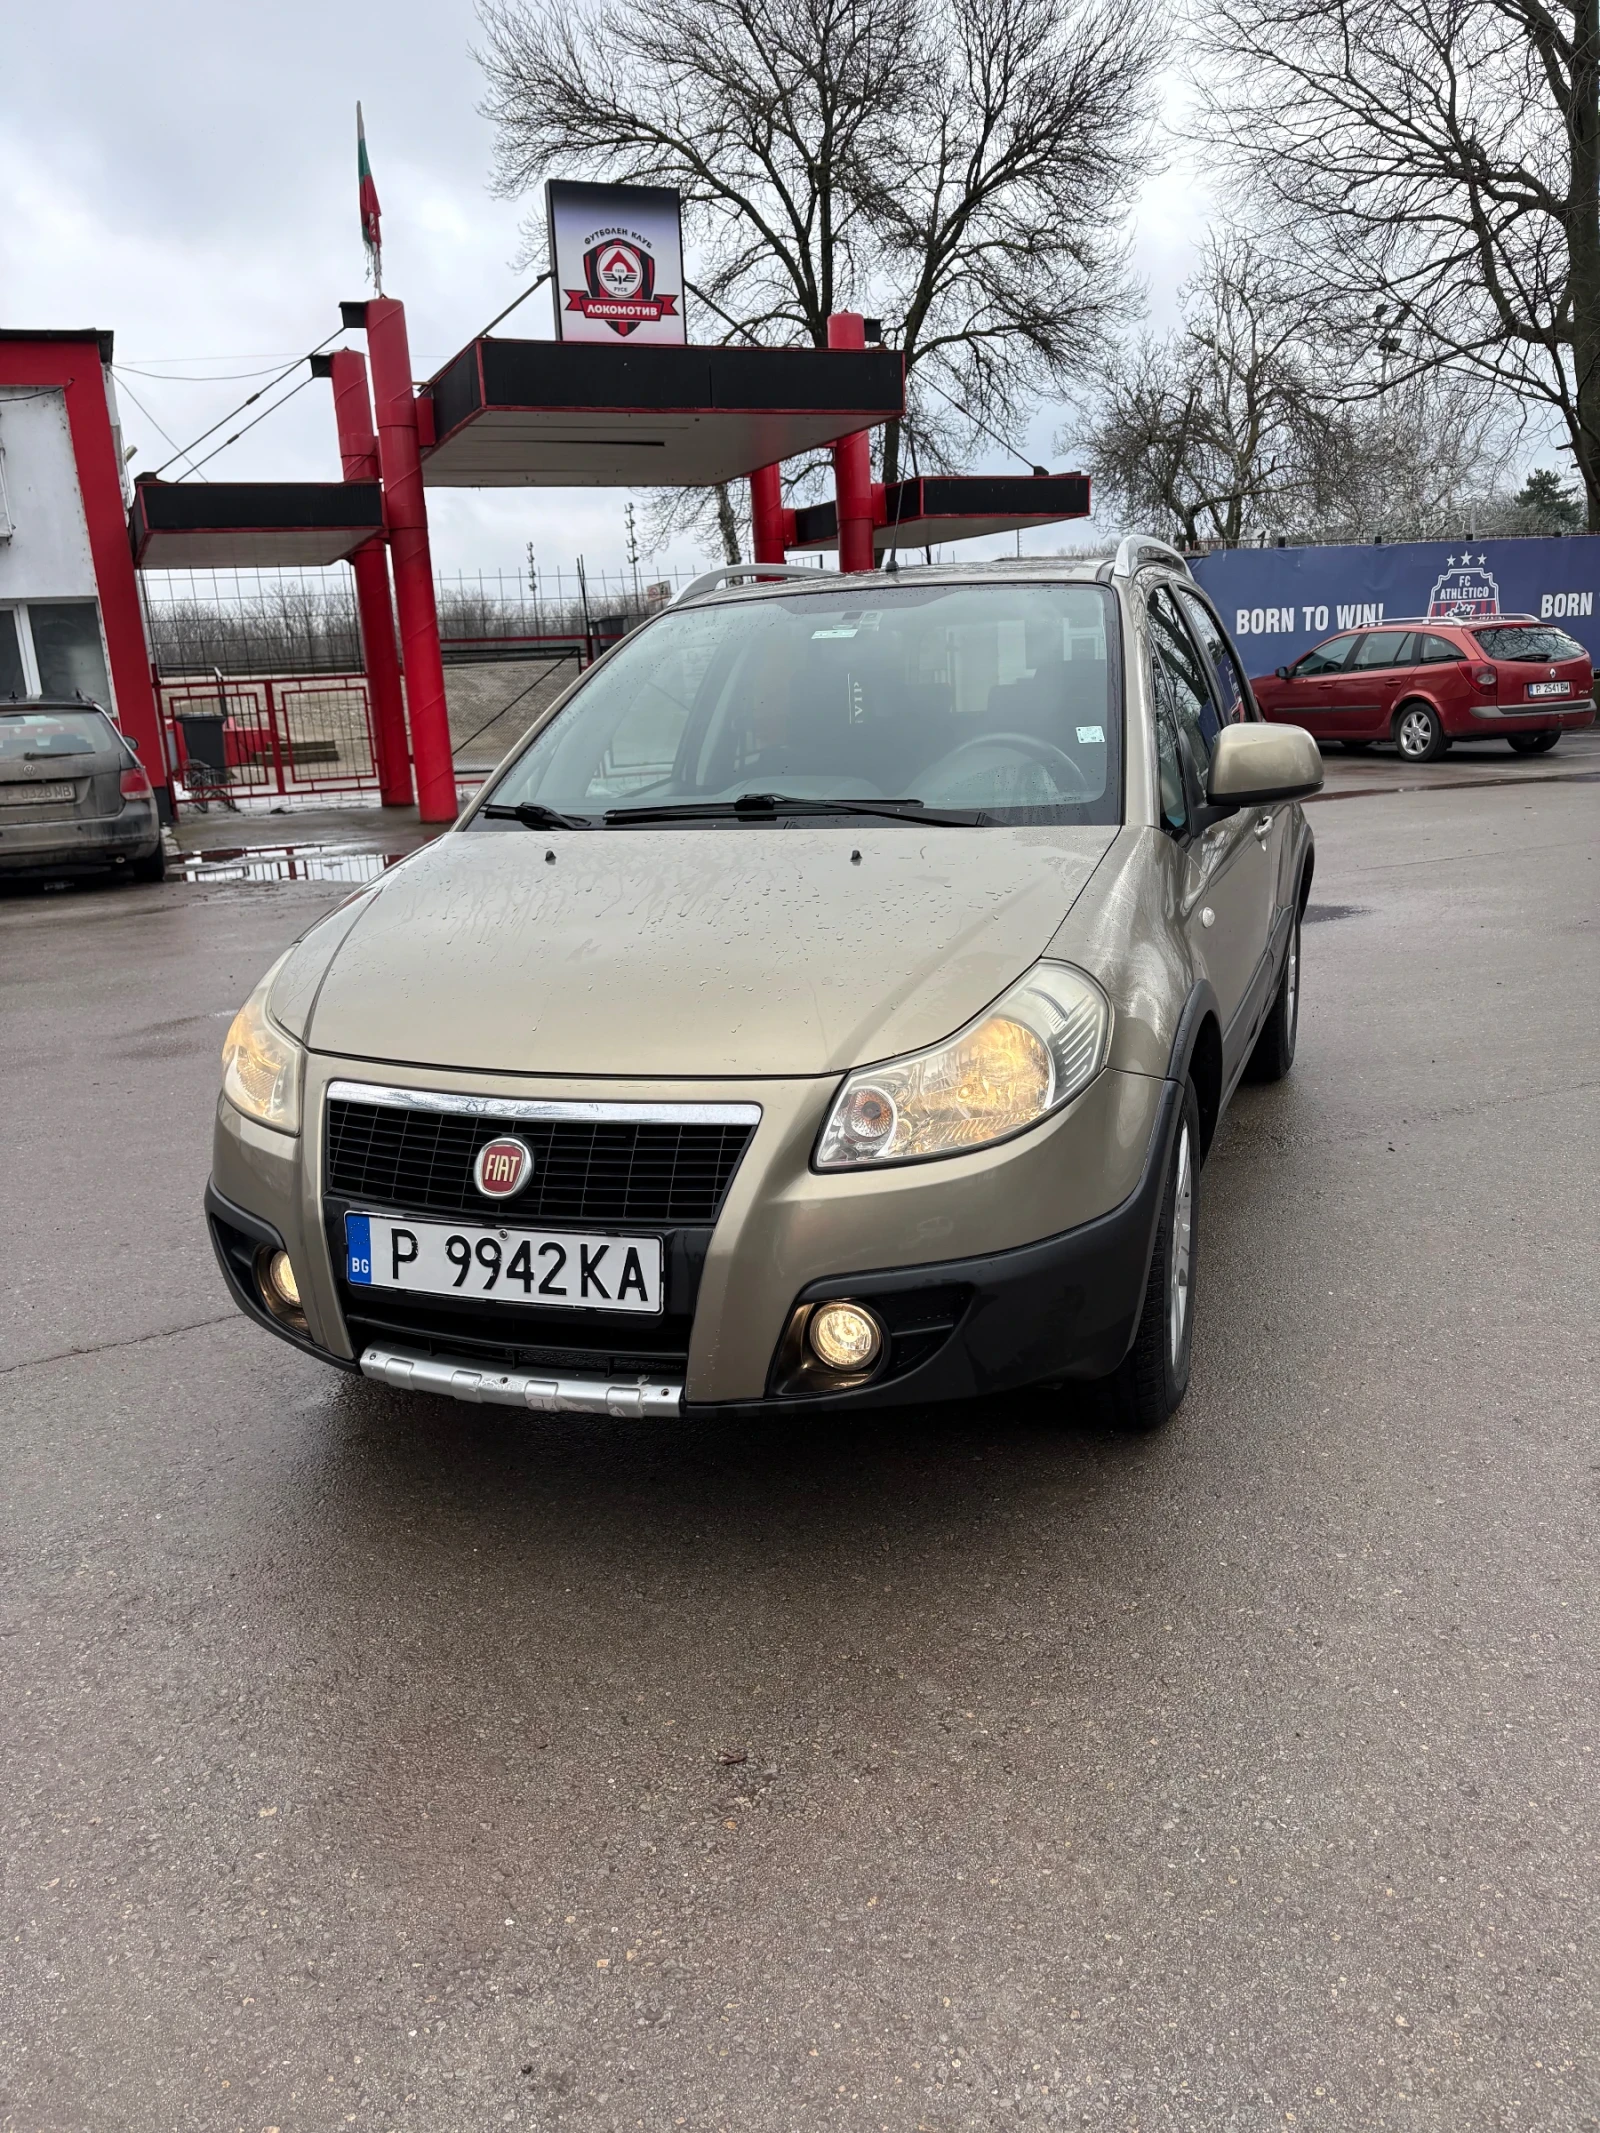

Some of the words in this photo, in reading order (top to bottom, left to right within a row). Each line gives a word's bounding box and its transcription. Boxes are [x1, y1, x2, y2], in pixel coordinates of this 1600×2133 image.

[584, 227, 628, 245] ФУТБОЛЕН
[631, 232, 653, 249] КЛУБ
[587, 304, 658, 316] ЛОКОМОТИВ
[1459, 575, 1471, 587] FC
[1440, 586, 1490, 600] ATHLETICO
[1541, 591, 1593, 618] BORN
[1236, 607, 1295, 635] BORN
[1302, 605, 1329, 632] TO
[1336, 603, 1384, 630] WIN!
[485, 1154, 520, 1182] FIAT
[391, 1228, 419, 1280] P
[351, 1257, 369, 1274] BG
